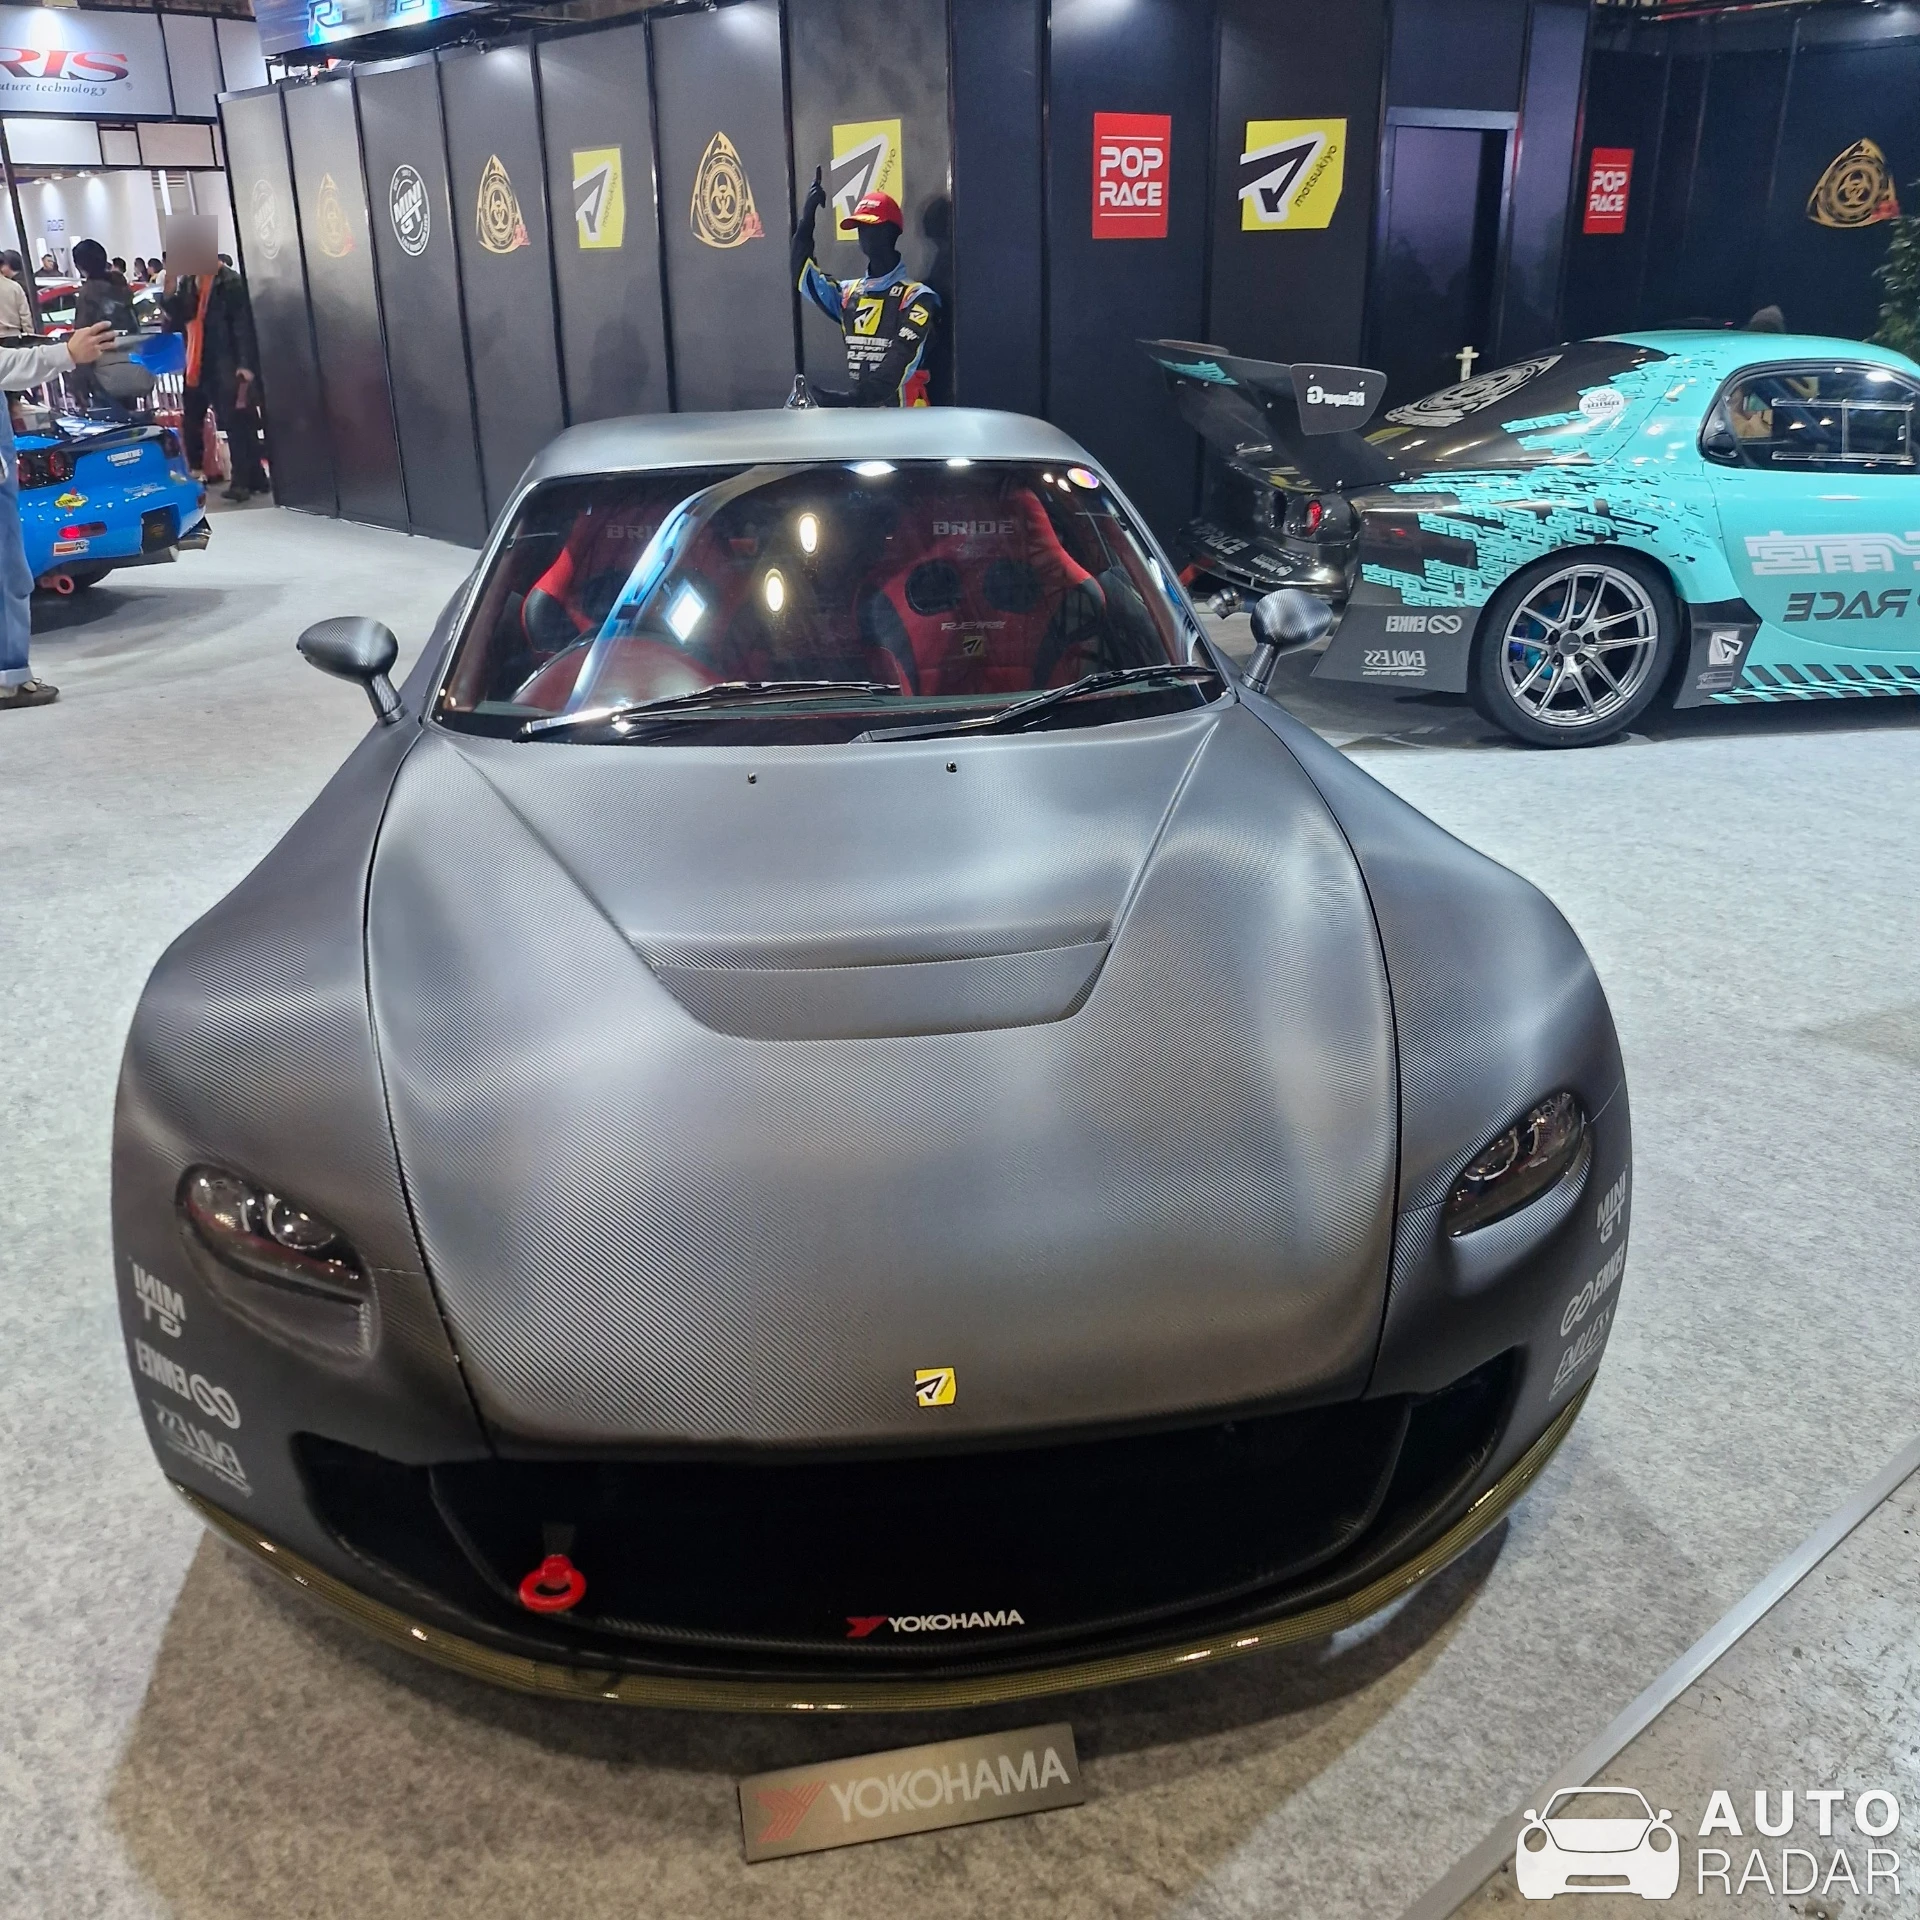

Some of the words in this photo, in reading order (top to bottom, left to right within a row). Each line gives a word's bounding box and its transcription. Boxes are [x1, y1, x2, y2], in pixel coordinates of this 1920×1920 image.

[36, 82, 107, 97] technology
[1100, 146, 1164, 178] POP
[1293, 144, 1338, 208] matsukiyo
[1099, 181, 1163, 207] RACE
[1591, 170, 1627, 193] POP
[393, 179, 422, 223] MINI
[400, 198, 423, 235] GT
[1589, 193, 1624, 212] RACE
[932, 520, 1015, 535] BRIDE
[1596, 1170, 1628, 1229] MINI
[1600, 1193, 1626, 1245] GT
[1591, 1239, 1626, 1305] ENKEI
[888, 1608, 1026, 1633] YOKOHAMA
[829, 1746, 1072, 1823] YOKOHAMA
